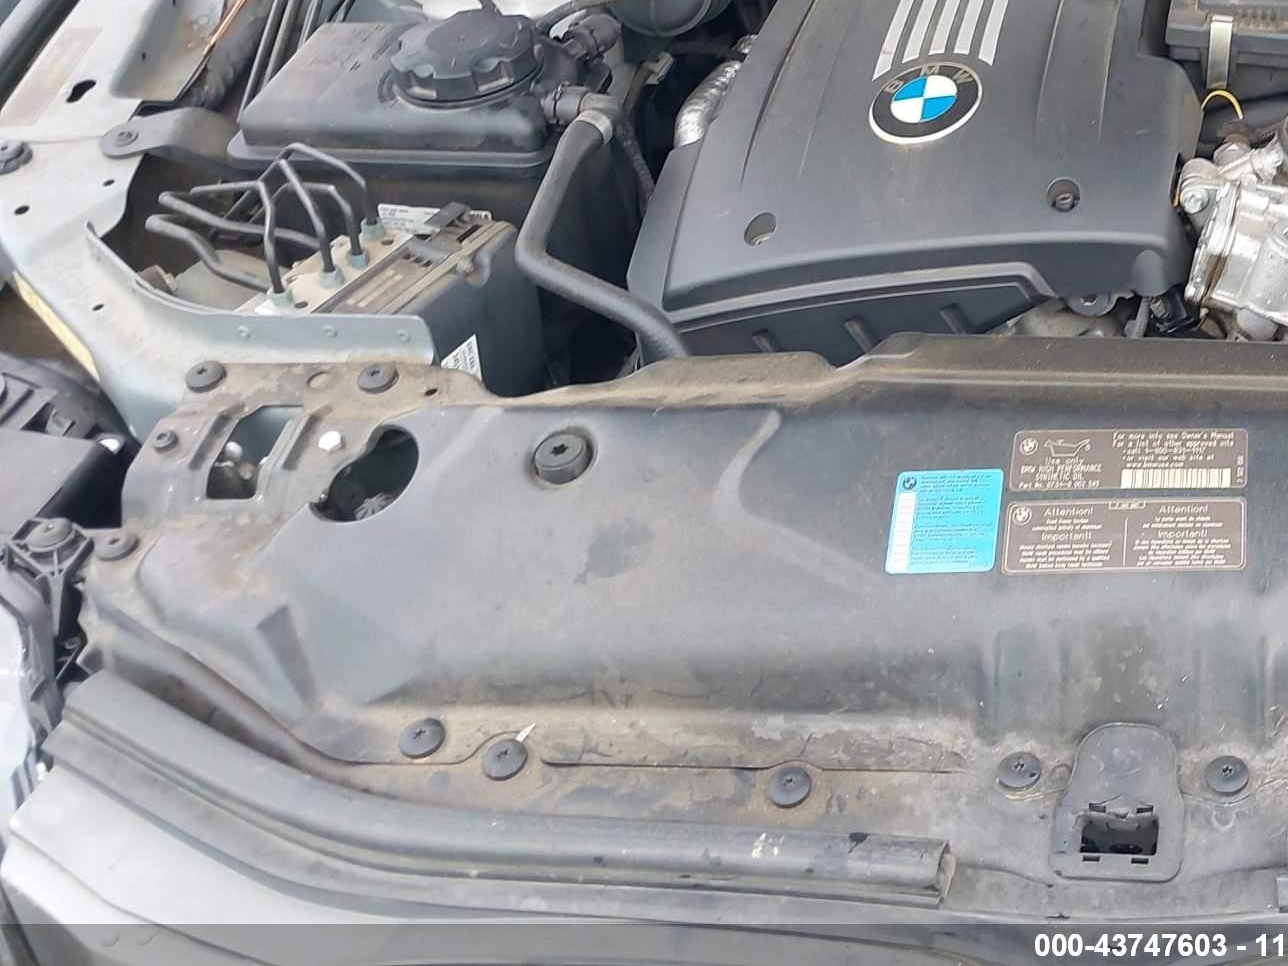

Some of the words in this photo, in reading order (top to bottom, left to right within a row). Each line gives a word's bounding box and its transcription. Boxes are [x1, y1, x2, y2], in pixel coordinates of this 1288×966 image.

[883, 65, 975, 94] BMW
[1045, 456, 1061, 465] Use
[1065, 456, 1085, 466] only
[1043, 506, 1094, 516] Attention!
[1159, 504, 1208, 514] Attention!
